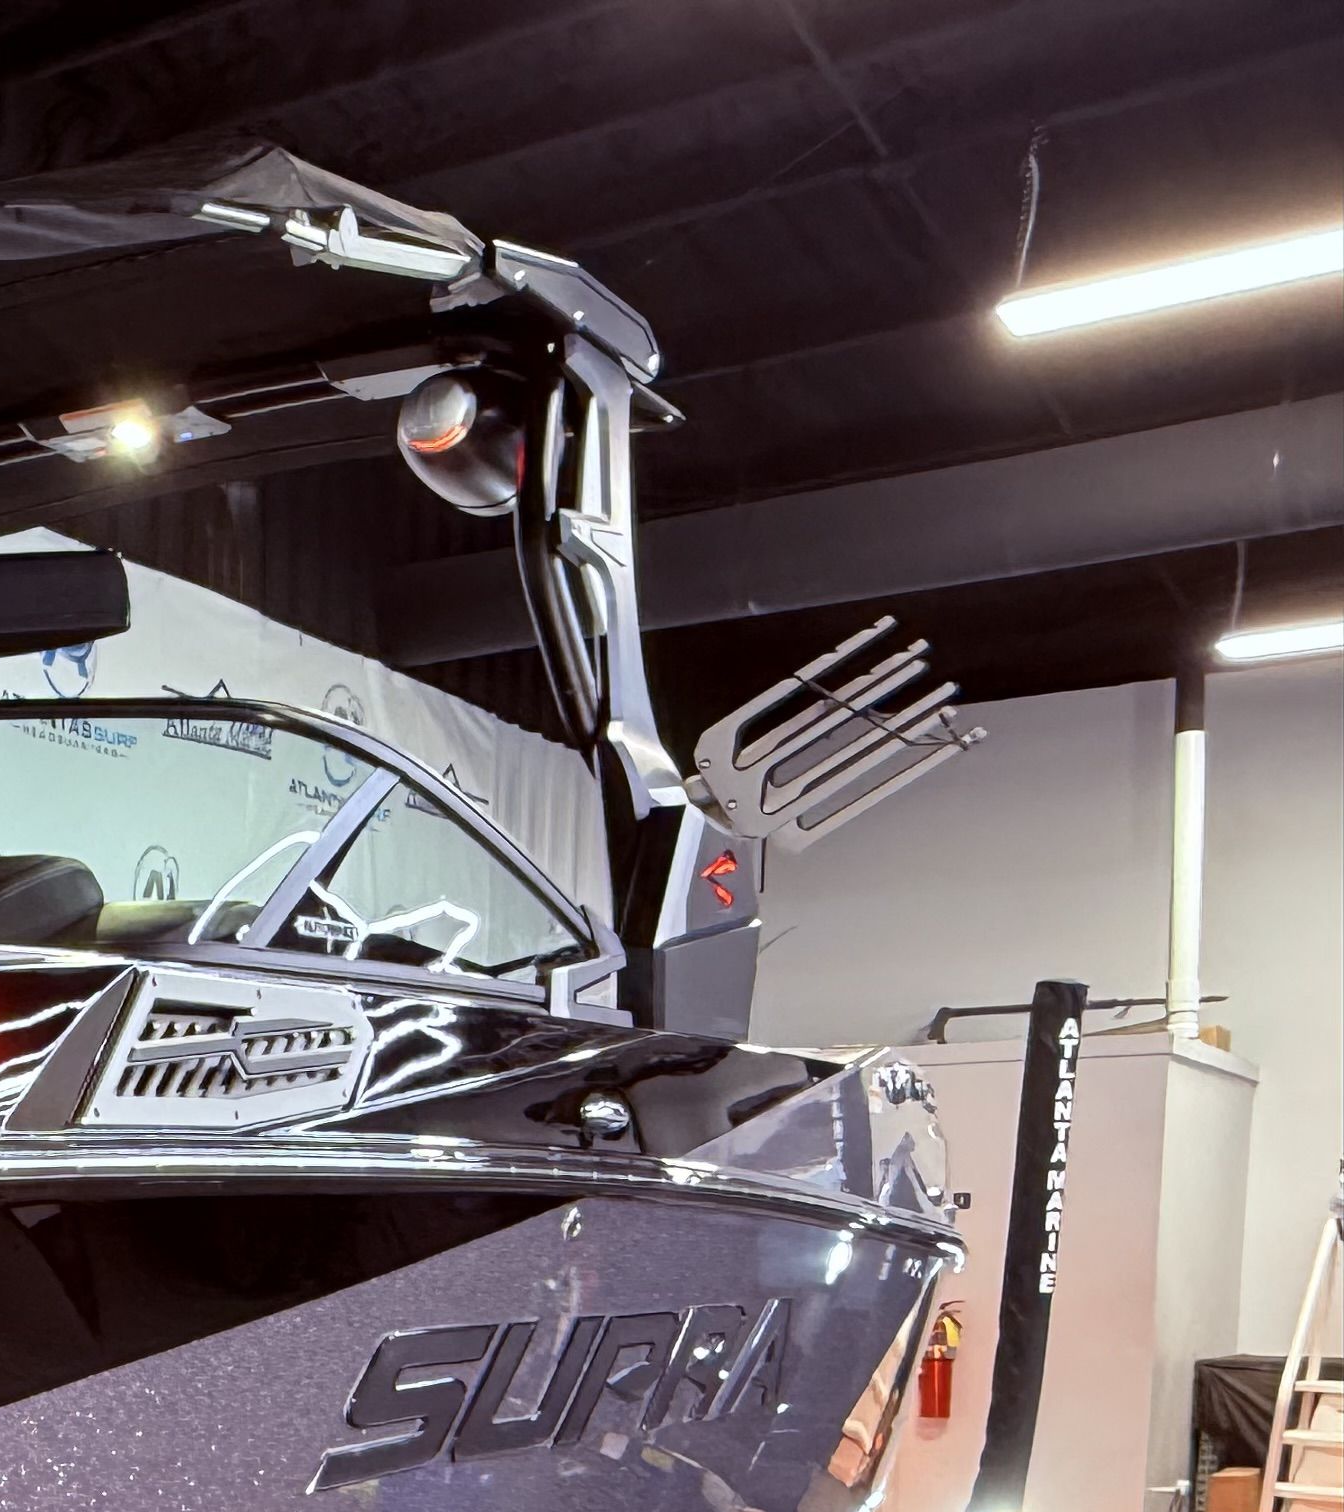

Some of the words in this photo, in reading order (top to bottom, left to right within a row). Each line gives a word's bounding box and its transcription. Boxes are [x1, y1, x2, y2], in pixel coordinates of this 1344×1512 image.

[1057, 1017, 1080, 1163] ATLANTA
[1038, 1169, 1065, 1294] MARINE
[306, 1298, 790, 1495] SUPRA
